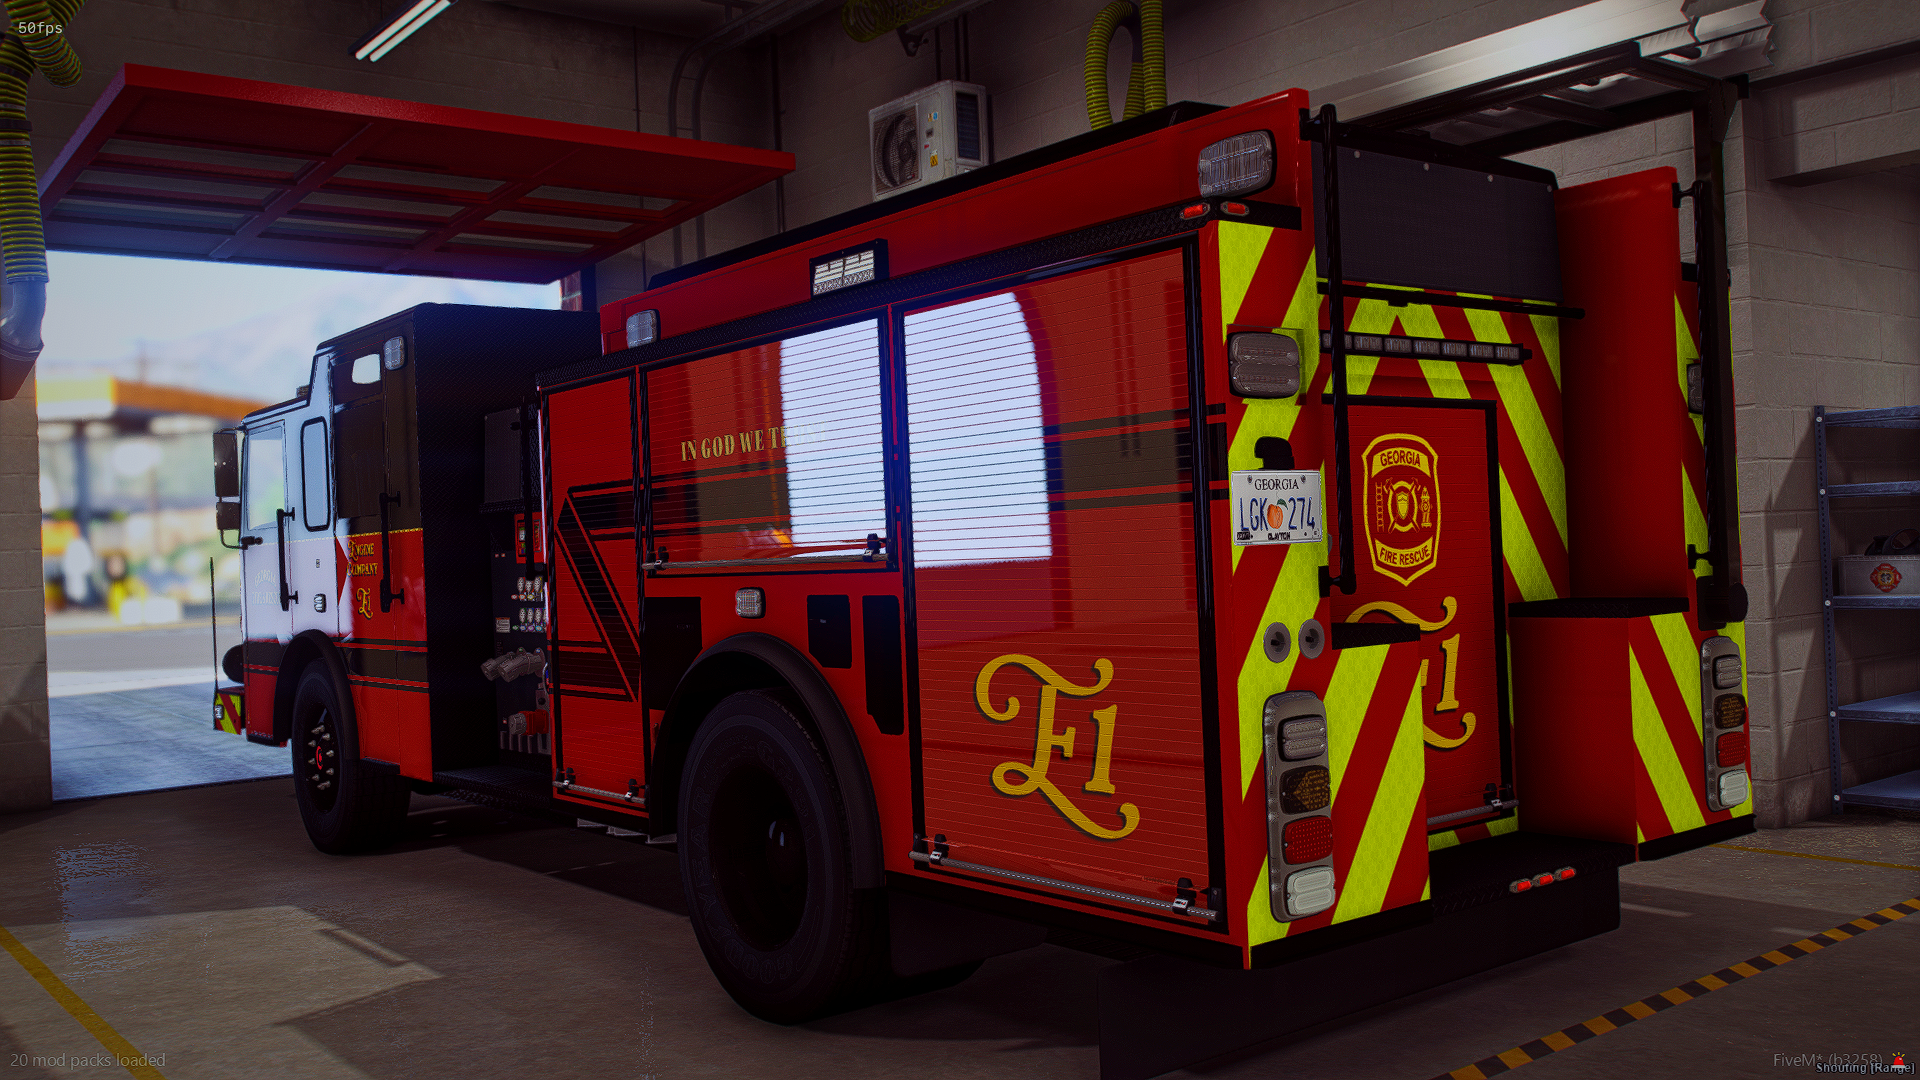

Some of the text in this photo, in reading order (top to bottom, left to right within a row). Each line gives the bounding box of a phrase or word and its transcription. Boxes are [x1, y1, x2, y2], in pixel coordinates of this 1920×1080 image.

[680, 439, 697, 462] IN
[700, 433, 735, 460] GOD
[738, 429, 765, 454] WE
[1379, 449, 1421, 467] GEORGIA
[1254, 478, 1300, 491] GEORGIA
[1239, 496, 1316, 532] LGK 274
[1379, 545, 1431, 567] FIRE RESCUE
[974, 653, 1141, 840] E1
